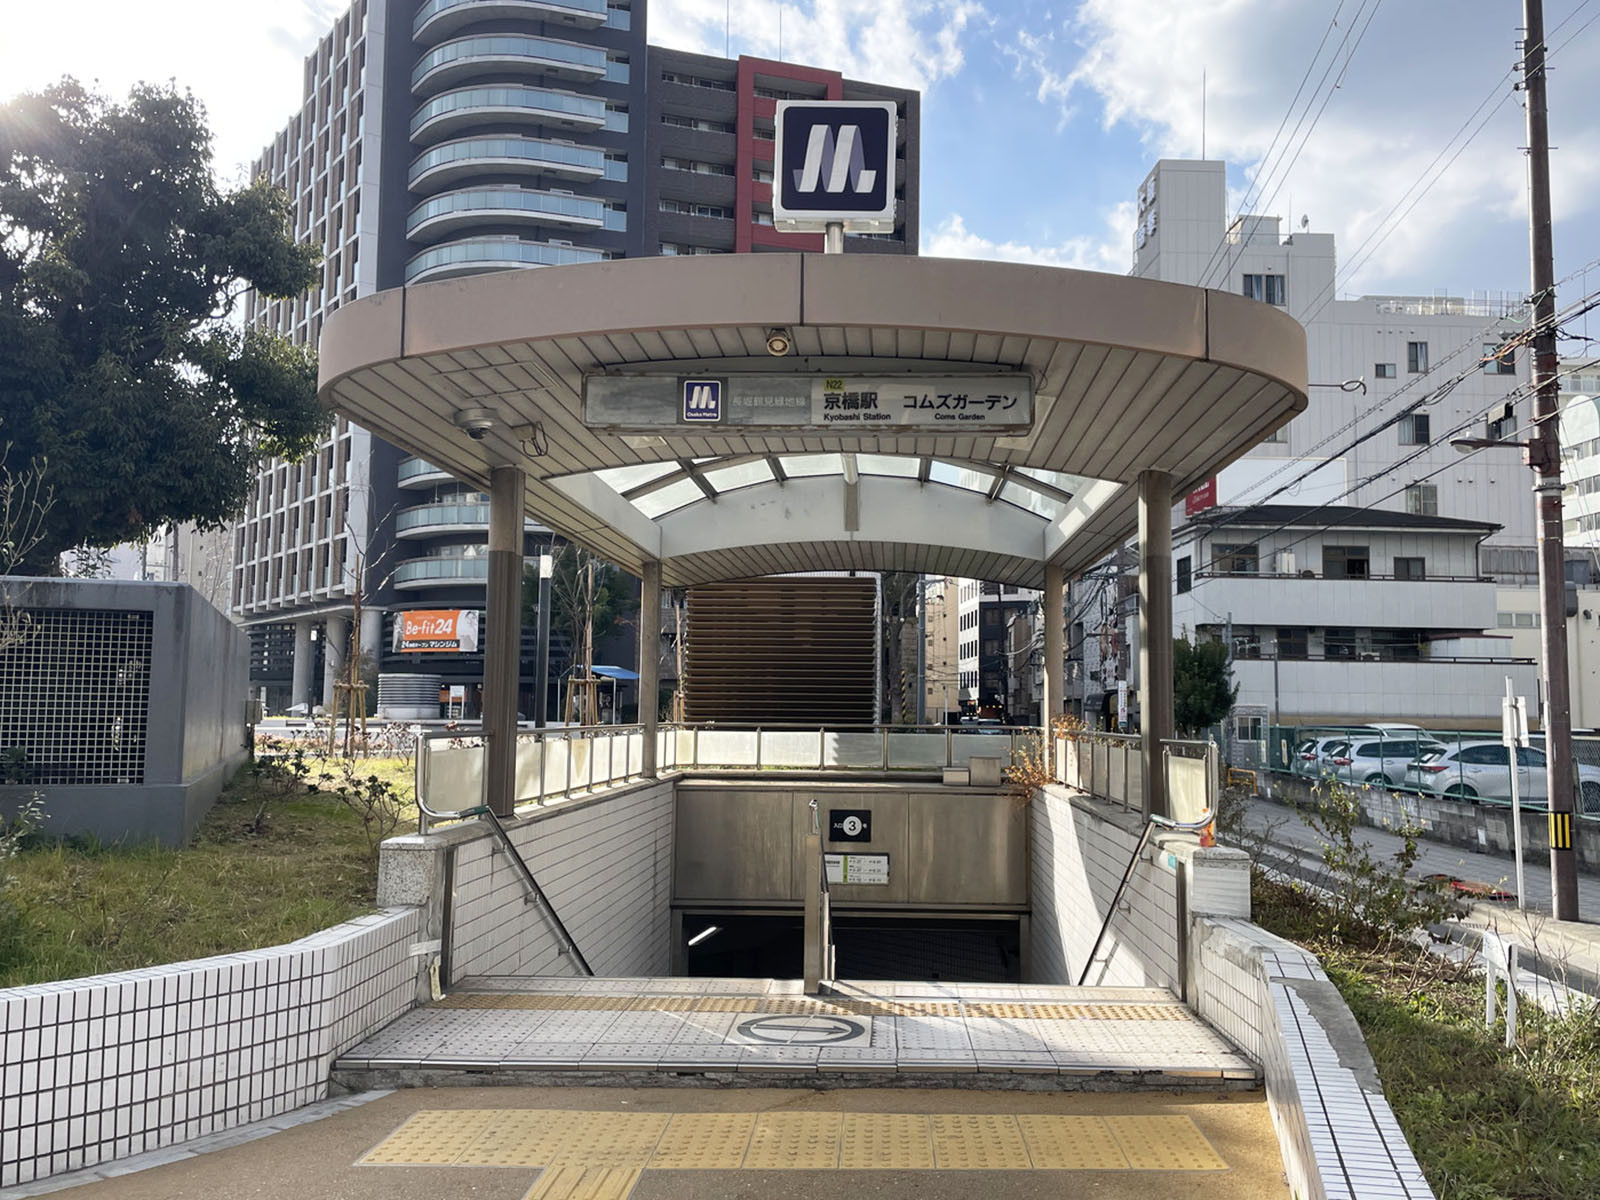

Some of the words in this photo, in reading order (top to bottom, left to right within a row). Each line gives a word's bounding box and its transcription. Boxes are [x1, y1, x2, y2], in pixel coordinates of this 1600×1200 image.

[826, 380, 843, 390] N22
[824, 391, 878, 410] 京橋駅
[903, 394, 1018, 410] コムズガーデン
[823, 413, 861, 422] Kyobashi
[863, 412, 892, 421] Station
[935, 412, 956, 421] Coms
[958, 412, 986, 421] Garden
[848, 820, 857, 832] 3
